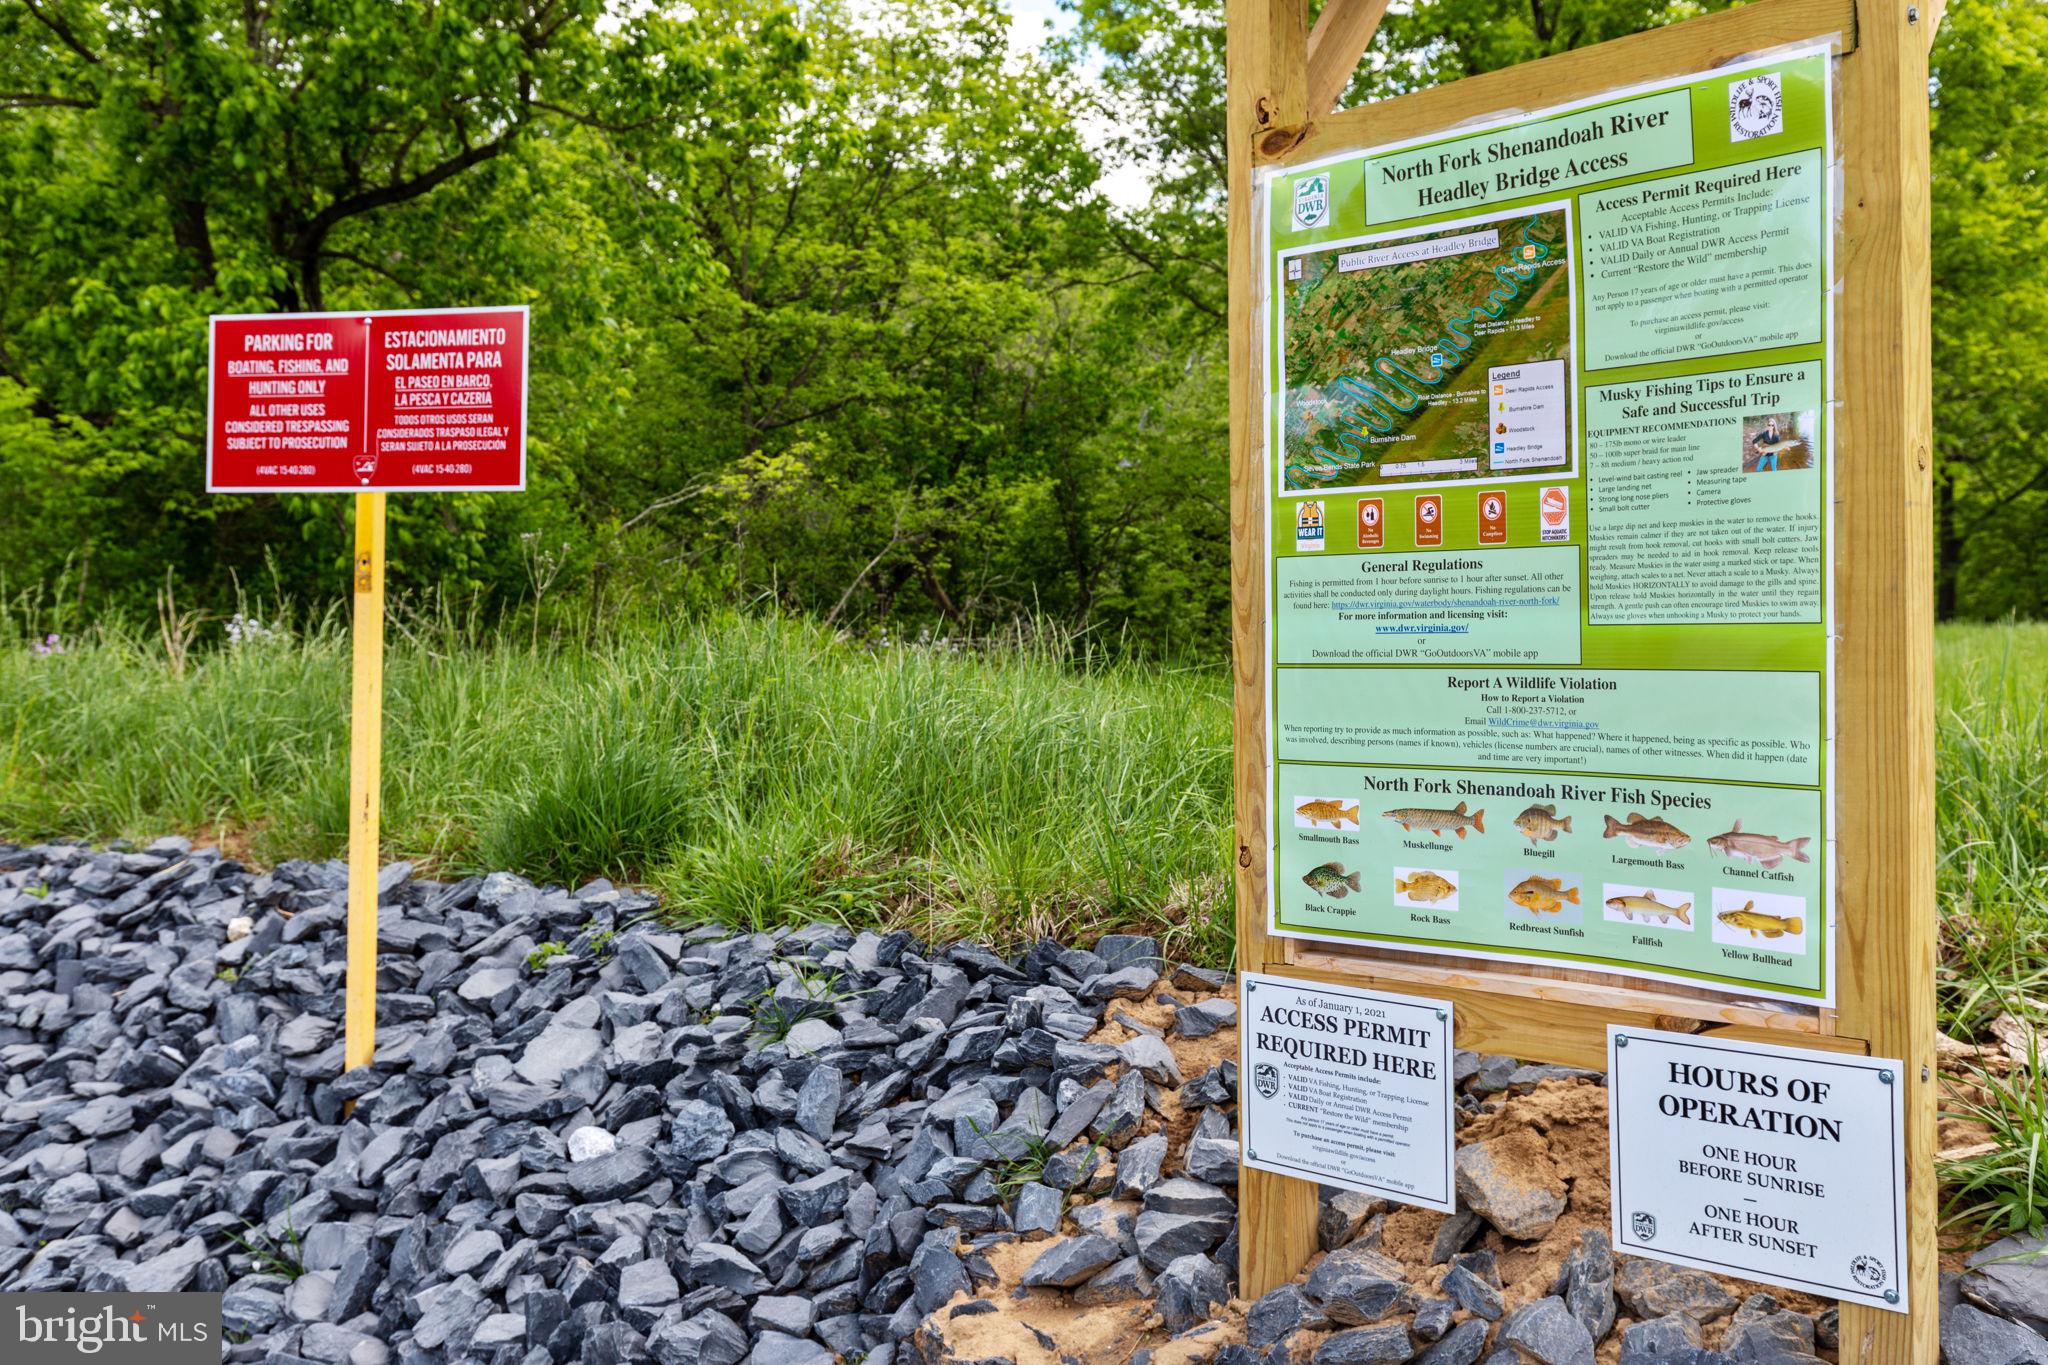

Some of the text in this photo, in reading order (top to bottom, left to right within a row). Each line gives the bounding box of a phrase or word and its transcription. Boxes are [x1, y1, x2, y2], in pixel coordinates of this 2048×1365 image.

[1382, 110, 1669, 184] North Fork Shenandoah River
[1418, 152, 1628, 207] Headley Bridge Access
[1595, 165, 1801, 212] Access Permit Required Here
[1298, 199, 1323, 214] DWR
[1621, 189, 1773, 223] Acceptable Access Permits Include:
[1599, 196, 1810, 239] VALID VA Fishing, Hunting, or Trapping License
[1340, 236, 1496, 268] Public River Access at Headley Bridge
[1600, 253, 1630, 265] VALID
[1631, 249, 1655, 261] Daily
[1667, 241, 1699, 255] Annual
[1701, 237, 1726, 249] DWR
[1727, 234, 1758, 245] Access
[1760, 227, 1789, 239] Permit
[1600, 267, 1631, 279] Current
[1671, 258, 1685, 268] the
[1714, 246, 1767, 261] membership
[244, 332, 333, 352] PARKING FOR
[384, 327, 506, 348] ESTACIONAMIENTO
[324, 358, 348, 374] AND
[386, 350, 502, 371] SOLAMENTA PARA
[249, 380, 326, 394] HUNTING ONLY
[395, 376, 406, 389] EL
[408, 375, 440, 389] PASEO
[441, 375, 454, 389] EN
[1599, 371, 1805, 402] Musky Fishing Tips to Ensure a
[395, 392, 492, 406] LA PESCA Y CAZERIA
[1622, 393, 1780, 419] Safe and Successful Trip
[249, 403, 325, 417] ALL OTHER USES
[467, 413, 493, 424] SERAN
[225, 419, 349, 433] CONSIDERED TRESPASSING
[435, 426, 475, 437] TRASPASO
[476, 426, 502, 437] ILEGAL
[503, 426, 509, 436] Y
[1587, 417, 1737, 438] EQUIPMENT RECOMMENDATIONS
[227, 436, 347, 449] SUBJECT TO PROSECUTION
[380, 441, 406, 452] SERAN
[434, 441, 440, 450] A
[441, 440, 451, 451] LA
[1297, 526, 1324, 537] WEAR IT
[1361, 558, 1483, 573] General Regulations
[1447, 676, 1617, 691] Report A Wildlife Violation
[1486, 706, 1502, 714] Call
[1363, 775, 1711, 810] North Fork Shenandoah River Fish Species
[1298, 833, 1359, 844] Smallmouth Bass
[1403, 840, 1453, 852] Muskellunge
[1523, 848, 1555, 859] Bluegill
[1612, 855, 1685, 870] Largemouth Bass
[1722, 866, 1794, 882] Channel Catfish
[1305, 903, 1356, 917] Black Crappie
[1410, 914, 1450, 924] Rock Bass
[1509, 922, 1584, 937] Redbreast Sunfish
[1632, 935, 1663, 947] Fallfish
[1721, 949, 1792, 967] Yellow Bullhead
[1295, 996, 1385, 1018] As of January 1, 2021
[1260, 1006, 1430, 1048] ACCESS PERMIT
[1256, 1032, 1436, 1080] REQUIRED HERE
[1668, 1061, 1830, 1104] HOURS OF
[1658, 1094, 1843, 1142] OPERATION
[1702, 1144, 1797, 1172] ONE HOUR
[1678, 1159, 1825, 1198] BEFORE SUNRISE
[1704, 1204, 1799, 1234] ONE HOUR
[1688, 1221, 1818, 1258] AFTER SUNSET
